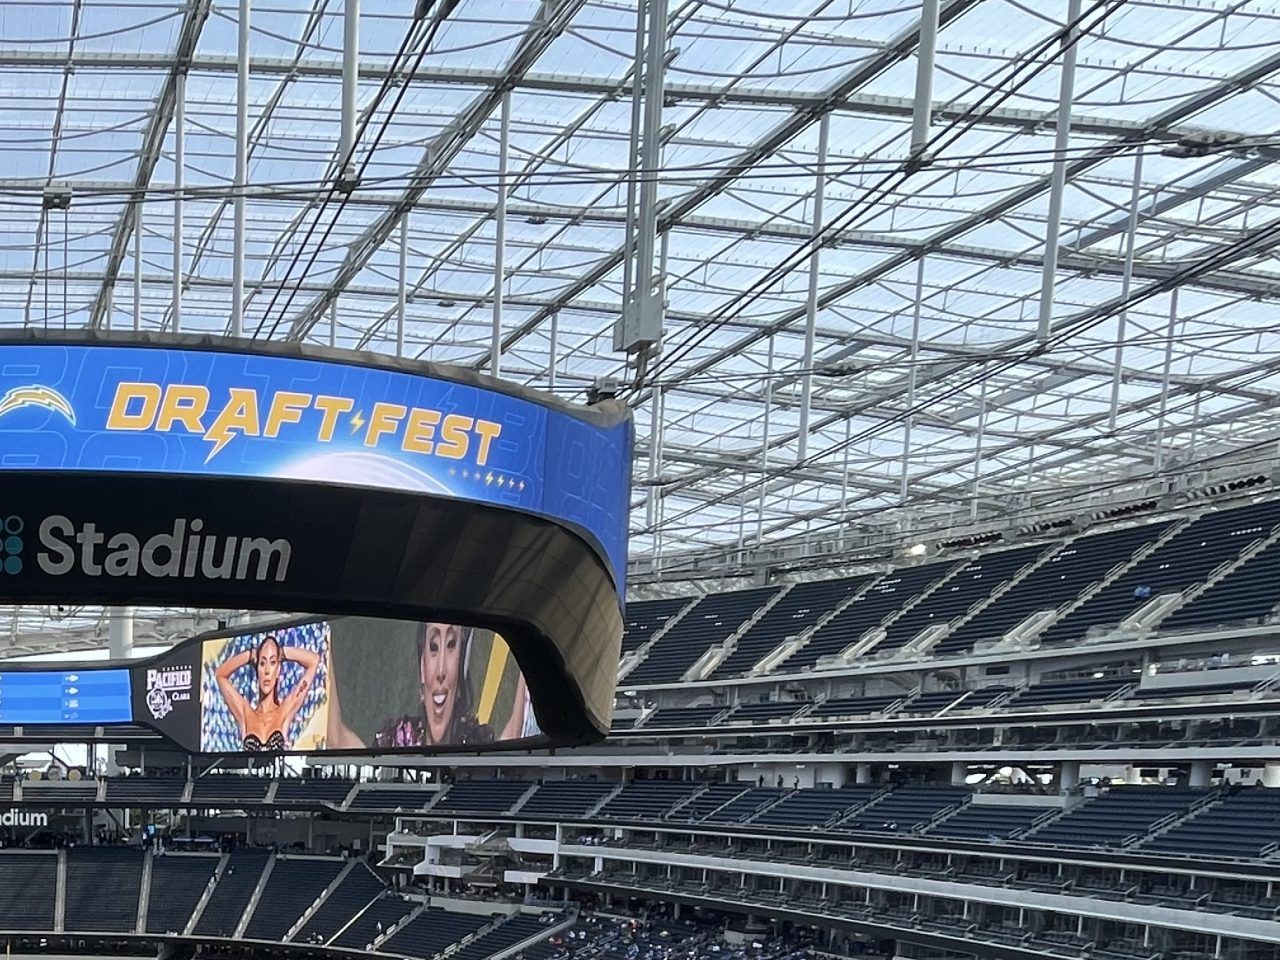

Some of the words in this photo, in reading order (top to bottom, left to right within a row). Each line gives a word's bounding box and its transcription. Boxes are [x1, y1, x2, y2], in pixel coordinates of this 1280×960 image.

[105, 382, 355, 464] DRAFT
[364, 402, 502, 467] FEST
[37, 514, 292, 582] Stadium
